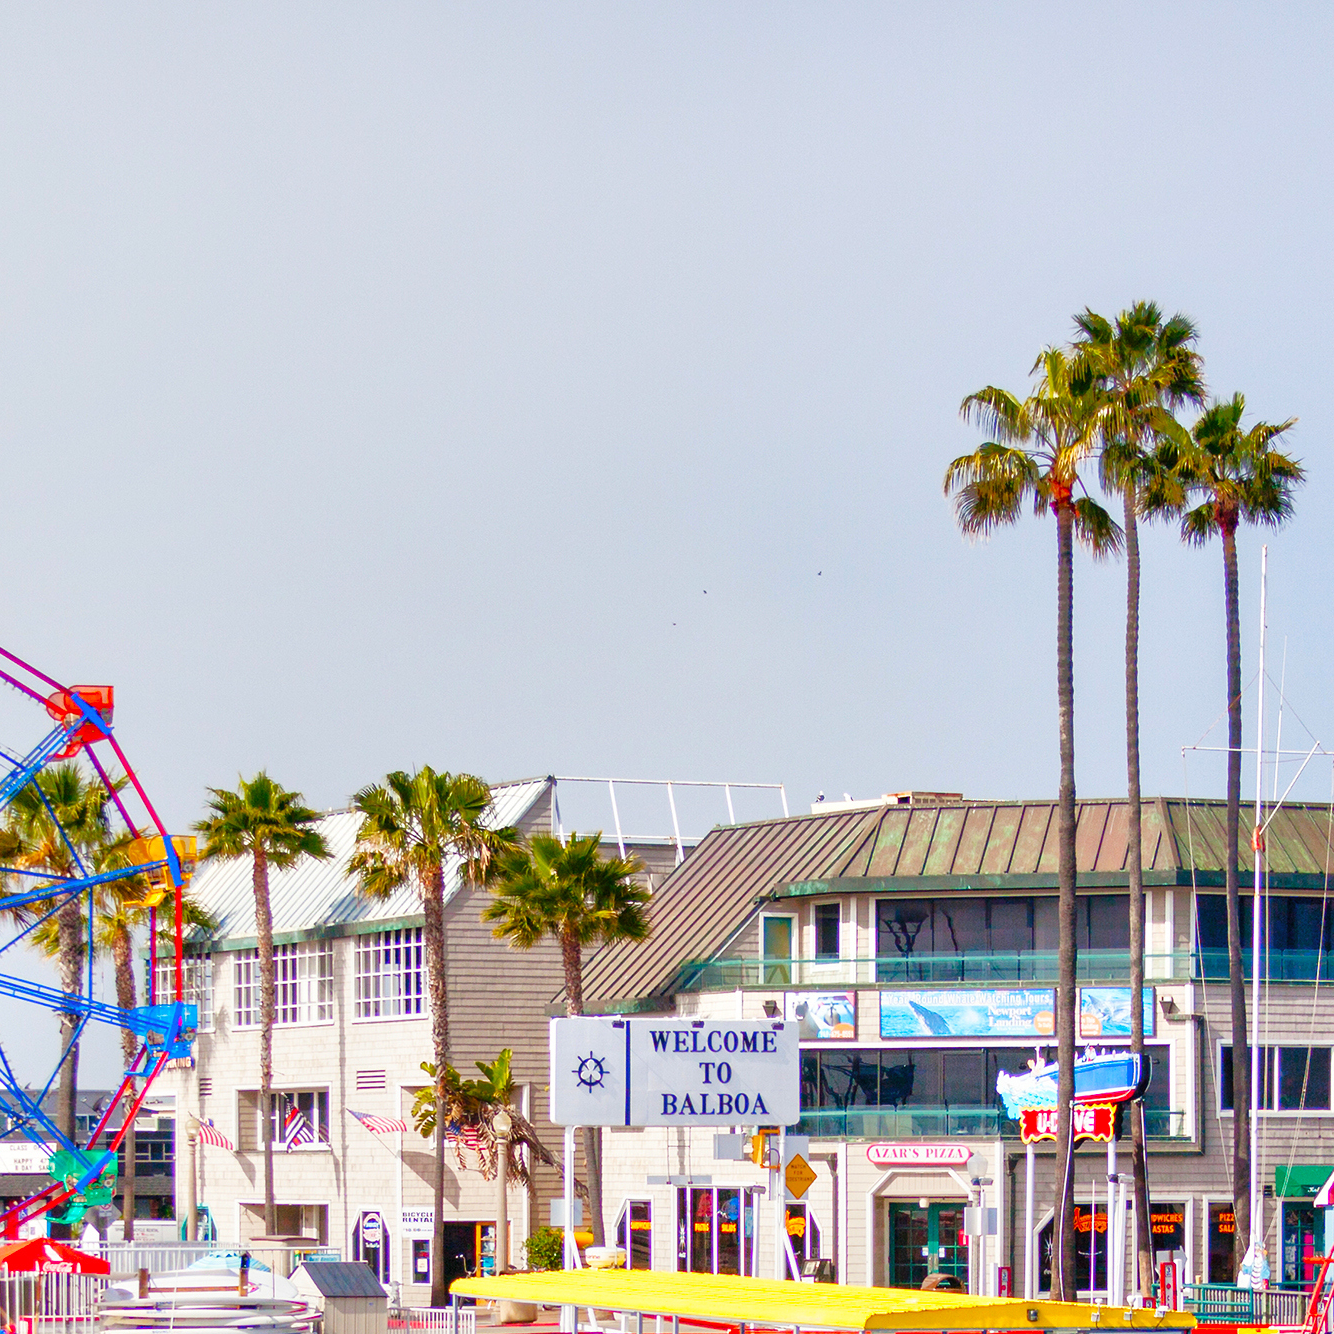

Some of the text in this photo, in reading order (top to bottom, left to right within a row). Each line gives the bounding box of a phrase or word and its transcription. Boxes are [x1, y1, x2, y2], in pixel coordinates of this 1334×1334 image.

[947, 993, 975, 1004] Whale
[977, 993, 1021, 1006] Watching
[988, 1006, 1032, 1018] Newport
[989, 1015, 1033, 1029] Landing
[649, 1030, 777, 1053] WELCOME
[699, 1062, 732, 1084] TO
[661, 1092, 770, 1115] BALBOA
[873, 1148, 964, 1158] AZAR'S PIZZA
[1219, 1213, 1234, 1222] PIZZ
[1151, 1224, 1175, 1234] ASTAS
